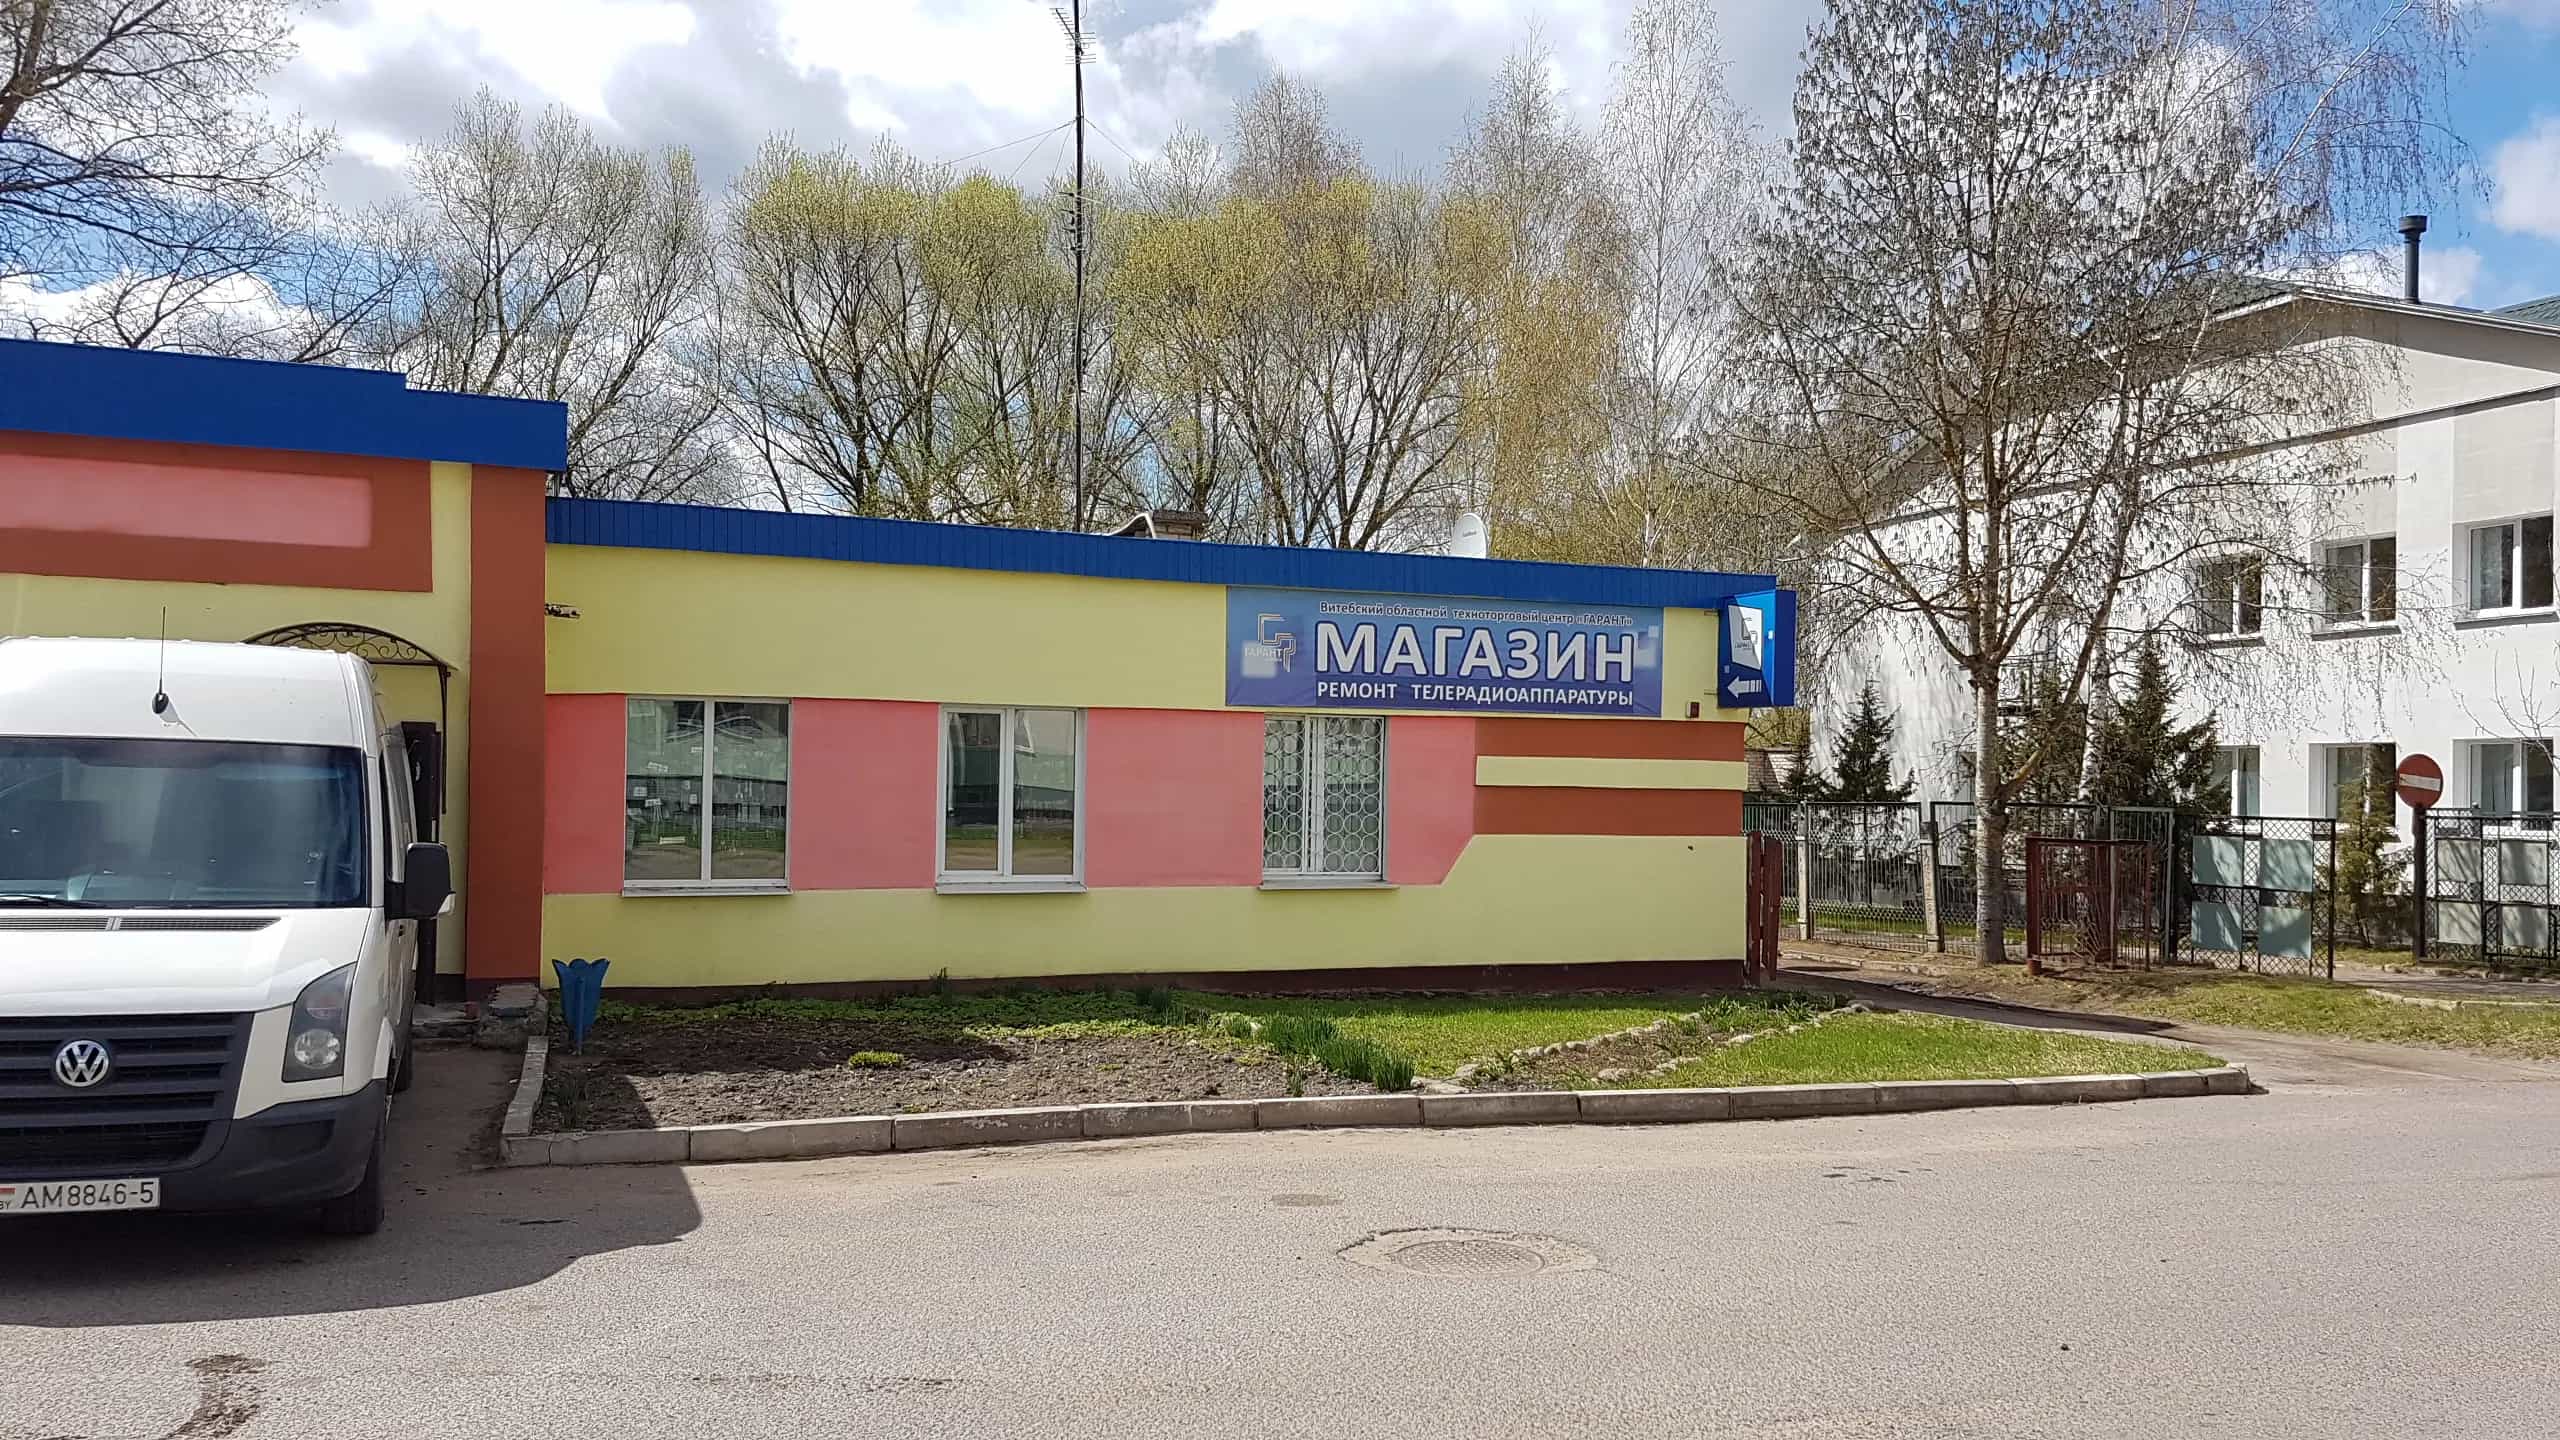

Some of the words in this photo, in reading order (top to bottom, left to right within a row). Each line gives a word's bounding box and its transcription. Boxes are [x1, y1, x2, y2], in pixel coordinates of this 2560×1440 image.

[1320, 601, 1384, 616] Витебский
[1386, 604, 1448, 618] областной
[1453, 608, 1538, 624] техноторговый
[1541, 611, 1573, 626] центр
[1315, 620, 1635, 683] МАГАЗИН
[1317, 681, 1398, 699] РЕМОНТ
[1411, 684, 1633, 706] ТЕЛЕРАДИОАППАРАТУРЫ
